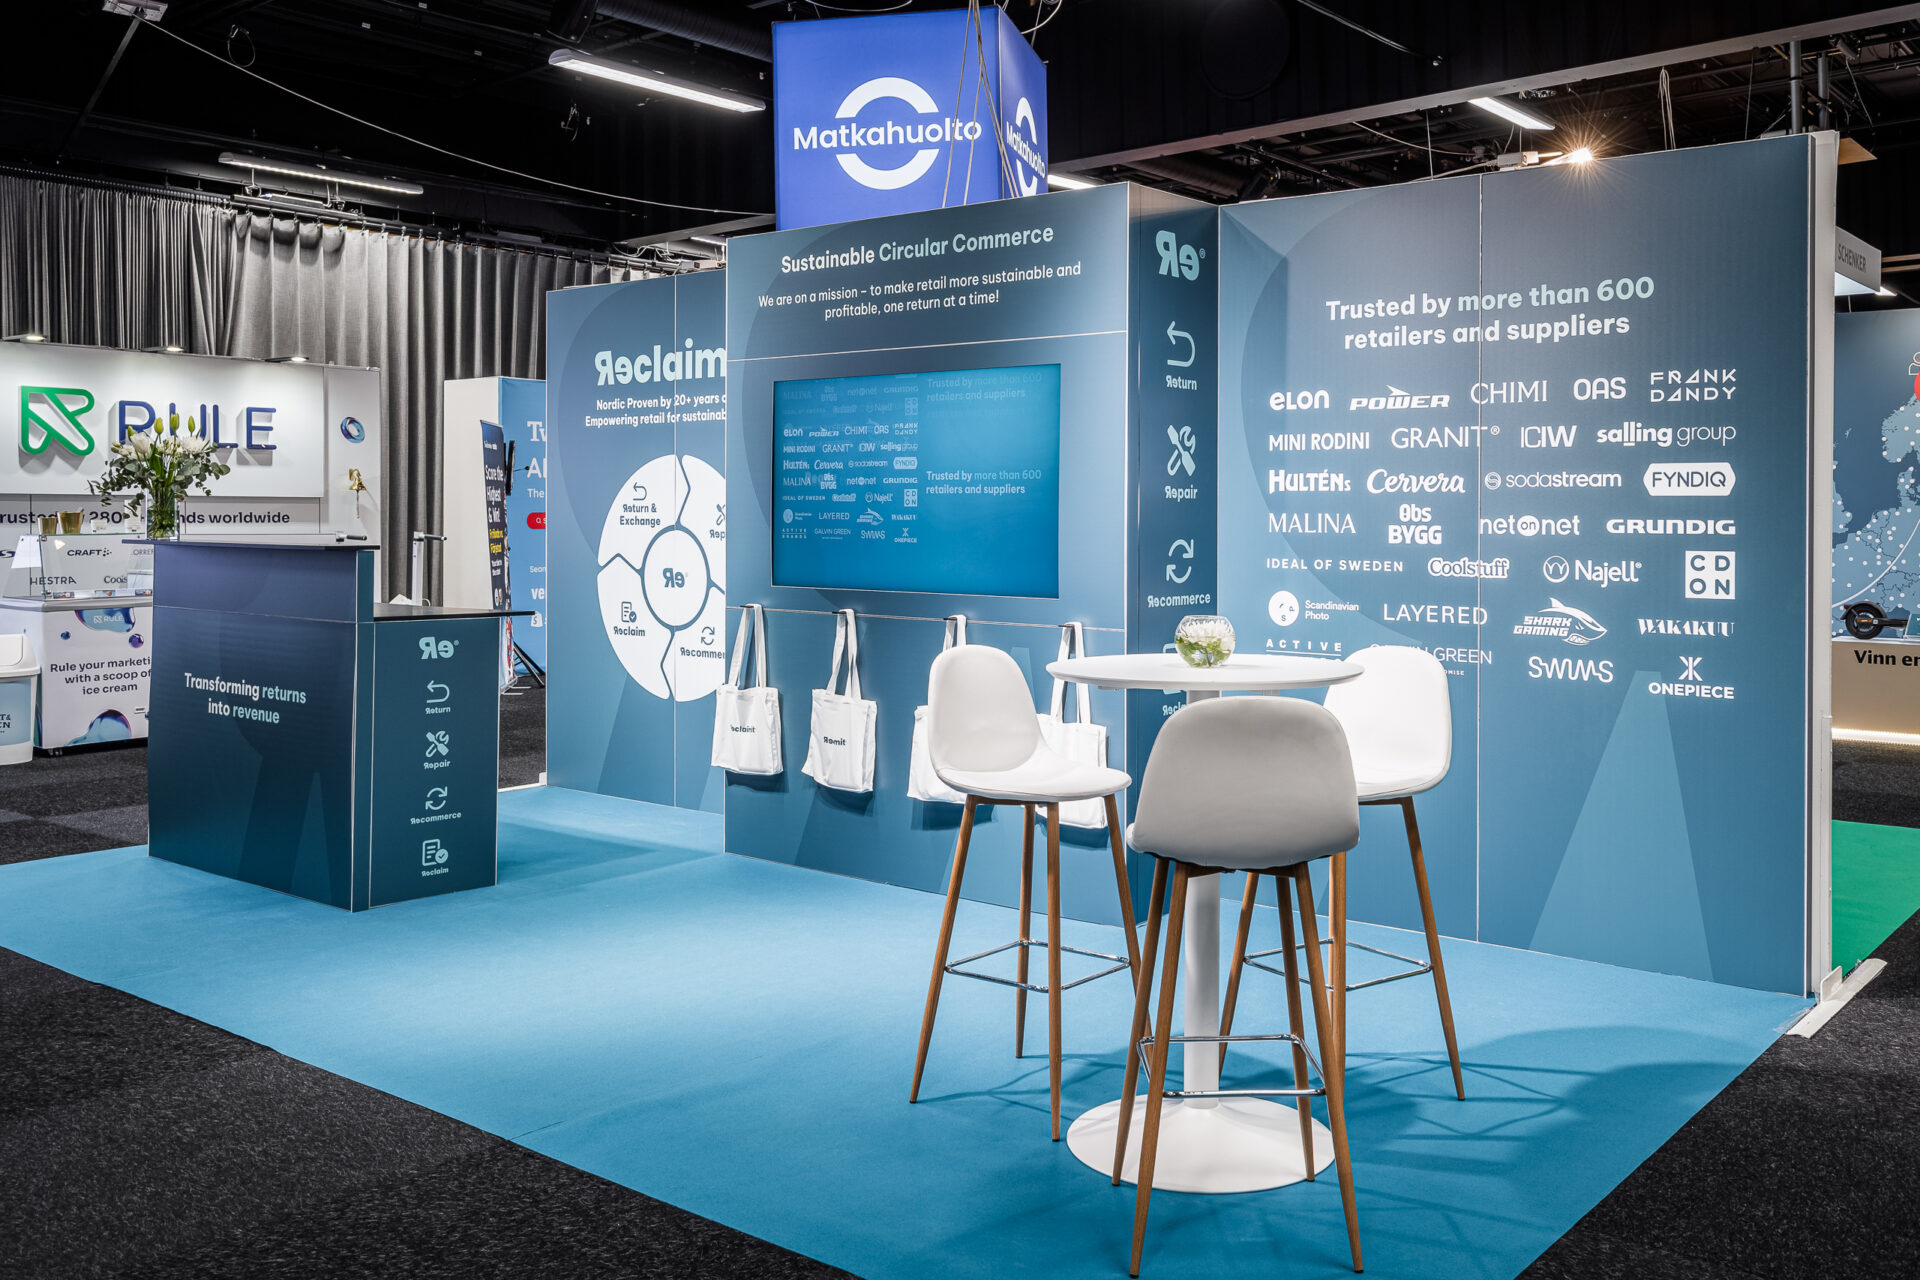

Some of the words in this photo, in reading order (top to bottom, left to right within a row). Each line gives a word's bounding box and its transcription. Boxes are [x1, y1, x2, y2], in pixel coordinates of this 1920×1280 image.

[793, 117, 982, 150] Matkahuolto
[1006, 121, 1045, 179] Matkahuolto
[781, 246, 875, 273] Sustainable
[879, 237, 948, 262] Circular
[952, 227, 1054, 253] Commerce
[1838, 243, 1867, 274] SCHENKER
[759, 295, 774, 308] We
[776, 295, 792, 305] are
[795, 294, 807, 304] on
[810, 293, 816, 302] a
[818, 287, 858, 301] mission
[870, 285, 882, 296] to
[884, 280, 914, 294] make
[916, 276, 947, 291] retail
[949, 275, 979, 288] more
[982, 264, 1053, 285] sustainable
[1056, 261, 1081, 277] and
[825, 302, 881, 321] profitable,
[883, 301, 904, 313] one
[906, 297, 941, 311] return
[943, 295, 956, 308] at
[958, 295, 966, 306] a
[969, 289, 999, 305] time!
[1326, 294, 1416, 321] Trusted
[1422, 293, 1452, 318] by
[1458, 290, 1523, 312] more
[1529, 283, 1590, 307] than
[1597, 276, 1655, 302] 600
[1345, 326, 1447, 350] retailers
[1453, 320, 1500, 343] and
[1507, 314, 1631, 344] suppliers
[1650, 368, 1737, 386] FRANK
[1470, 380, 1548, 404] CHIMI
[1573, 377, 1627, 400] OAS
[1650, 386, 1737, 402] DANDY
[596, 398, 625, 410] Nordic
[627, 398, 658, 409] Proven
[660, 396, 674, 409] by
[674, 394, 691, 406] 20+
[694, 394, 720, 407] years
[1350, 394, 1450, 411] POWER
[118, 400, 277, 450] RULE
[586, 414, 638, 428] Empowering
[640, 412, 665, 424] retail
[667, 412, 680, 423] for
[682, 408, 726, 422] sustainab
[844, 426, 868, 435] CHIMI
[1520, 425, 1578, 448] ICIW
[1596, 421, 1673, 447] salling
[1676, 426, 1736, 447] group
[1269, 433, 1306, 451] MINI
[1311, 432, 1370, 450] RODINI
[926, 470, 960, 480] Trusted
[962, 470, 972, 482] by
[974, 472, 996, 480] more
[999, 470, 1020, 479] than
[1022, 469, 1042, 480] 600
[1366, 468, 1466, 494] Cervera
[1505, 471, 1622, 488] sodastream
[1652, 471, 1727, 488] FYNDIQ
[528, 488, 544, 498] The
[926, 484, 962, 494] retailers
[965, 484, 982, 494] and
[984, 484, 1026, 496] suppliers
[650, 503, 657, 513] &
[209, 512, 290, 524] worldwide
[620, 516, 660, 528] Exchange
[1268, 512, 1357, 534] MALINA
[1606, 518, 1736, 534] GRUNDIG
[1388, 525, 1442, 545] BYGG
[1266, 558, 1308, 570] IDEAL
[1314, 559, 1333, 570] OF
[1339, 559, 1404, 572] SWEDEN
[1429, 558, 1509, 578] Coolstuff
[30, 576, 78, 586] HESTRA
[1304, 600, 1360, 611] Scandinavian
[1304, 612, 1330, 620] Photo
[1384, 604, 1488, 625] LAYERED
[1523, 616, 1572, 626] SHARK
[1513, 625, 1570, 637] GAMING
[1266, 638, 1342, 652] ACTIVE
[50, 662, 76, 672] Rule
[80, 660, 104, 672] your
[108, 656, 150, 668] marketi
[1434, 647, 1492, 664] GREEN
[1854, 650, 1896, 665] Vinn
[65, 674, 92, 684] with
[103, 672, 138, 682] scoop
[82, 686, 100, 695] ice
[102, 683, 138, 693] cream
[184, 672, 260, 701] Transforming
[262, 686, 307, 704] returns
[1648, 682, 1735, 700] ONEPIECE
[208, 698, 230, 716] into
[232, 706, 280, 724] revenue
